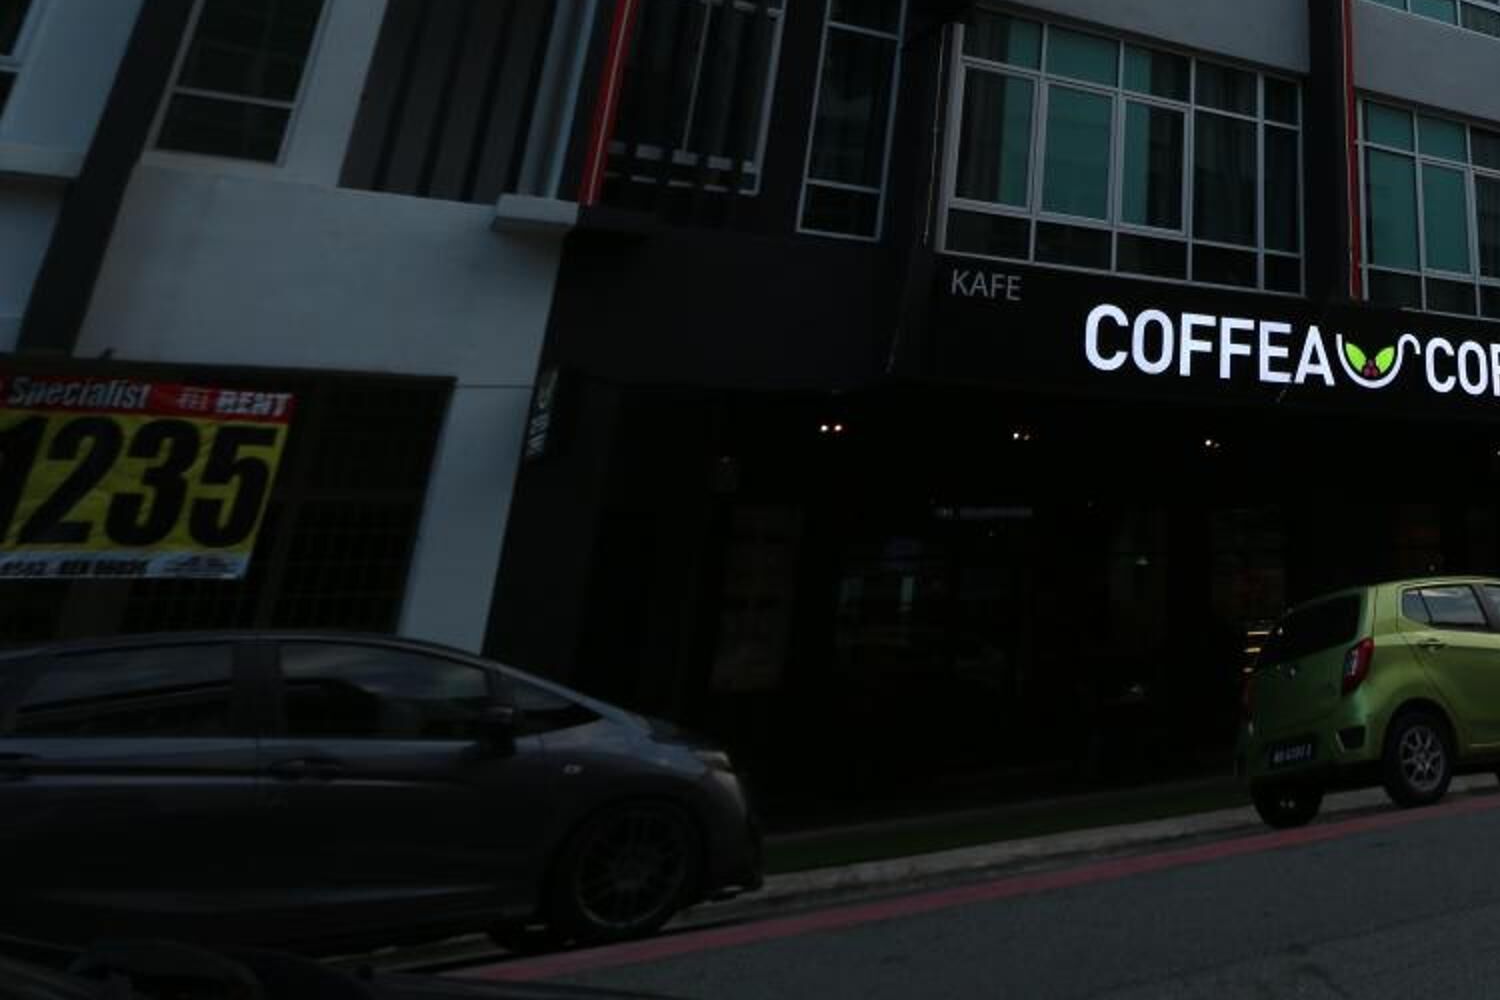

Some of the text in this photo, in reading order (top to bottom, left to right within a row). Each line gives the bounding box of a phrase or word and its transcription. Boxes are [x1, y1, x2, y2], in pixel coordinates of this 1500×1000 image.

[950, 267, 1024, 302] KAFE
[1083, 302, 1336, 389] COFFEA
[7, 374, 151, 410] Specialist
[216, 390, 293, 417] RENT
[0, 416, 278, 547] 1235
